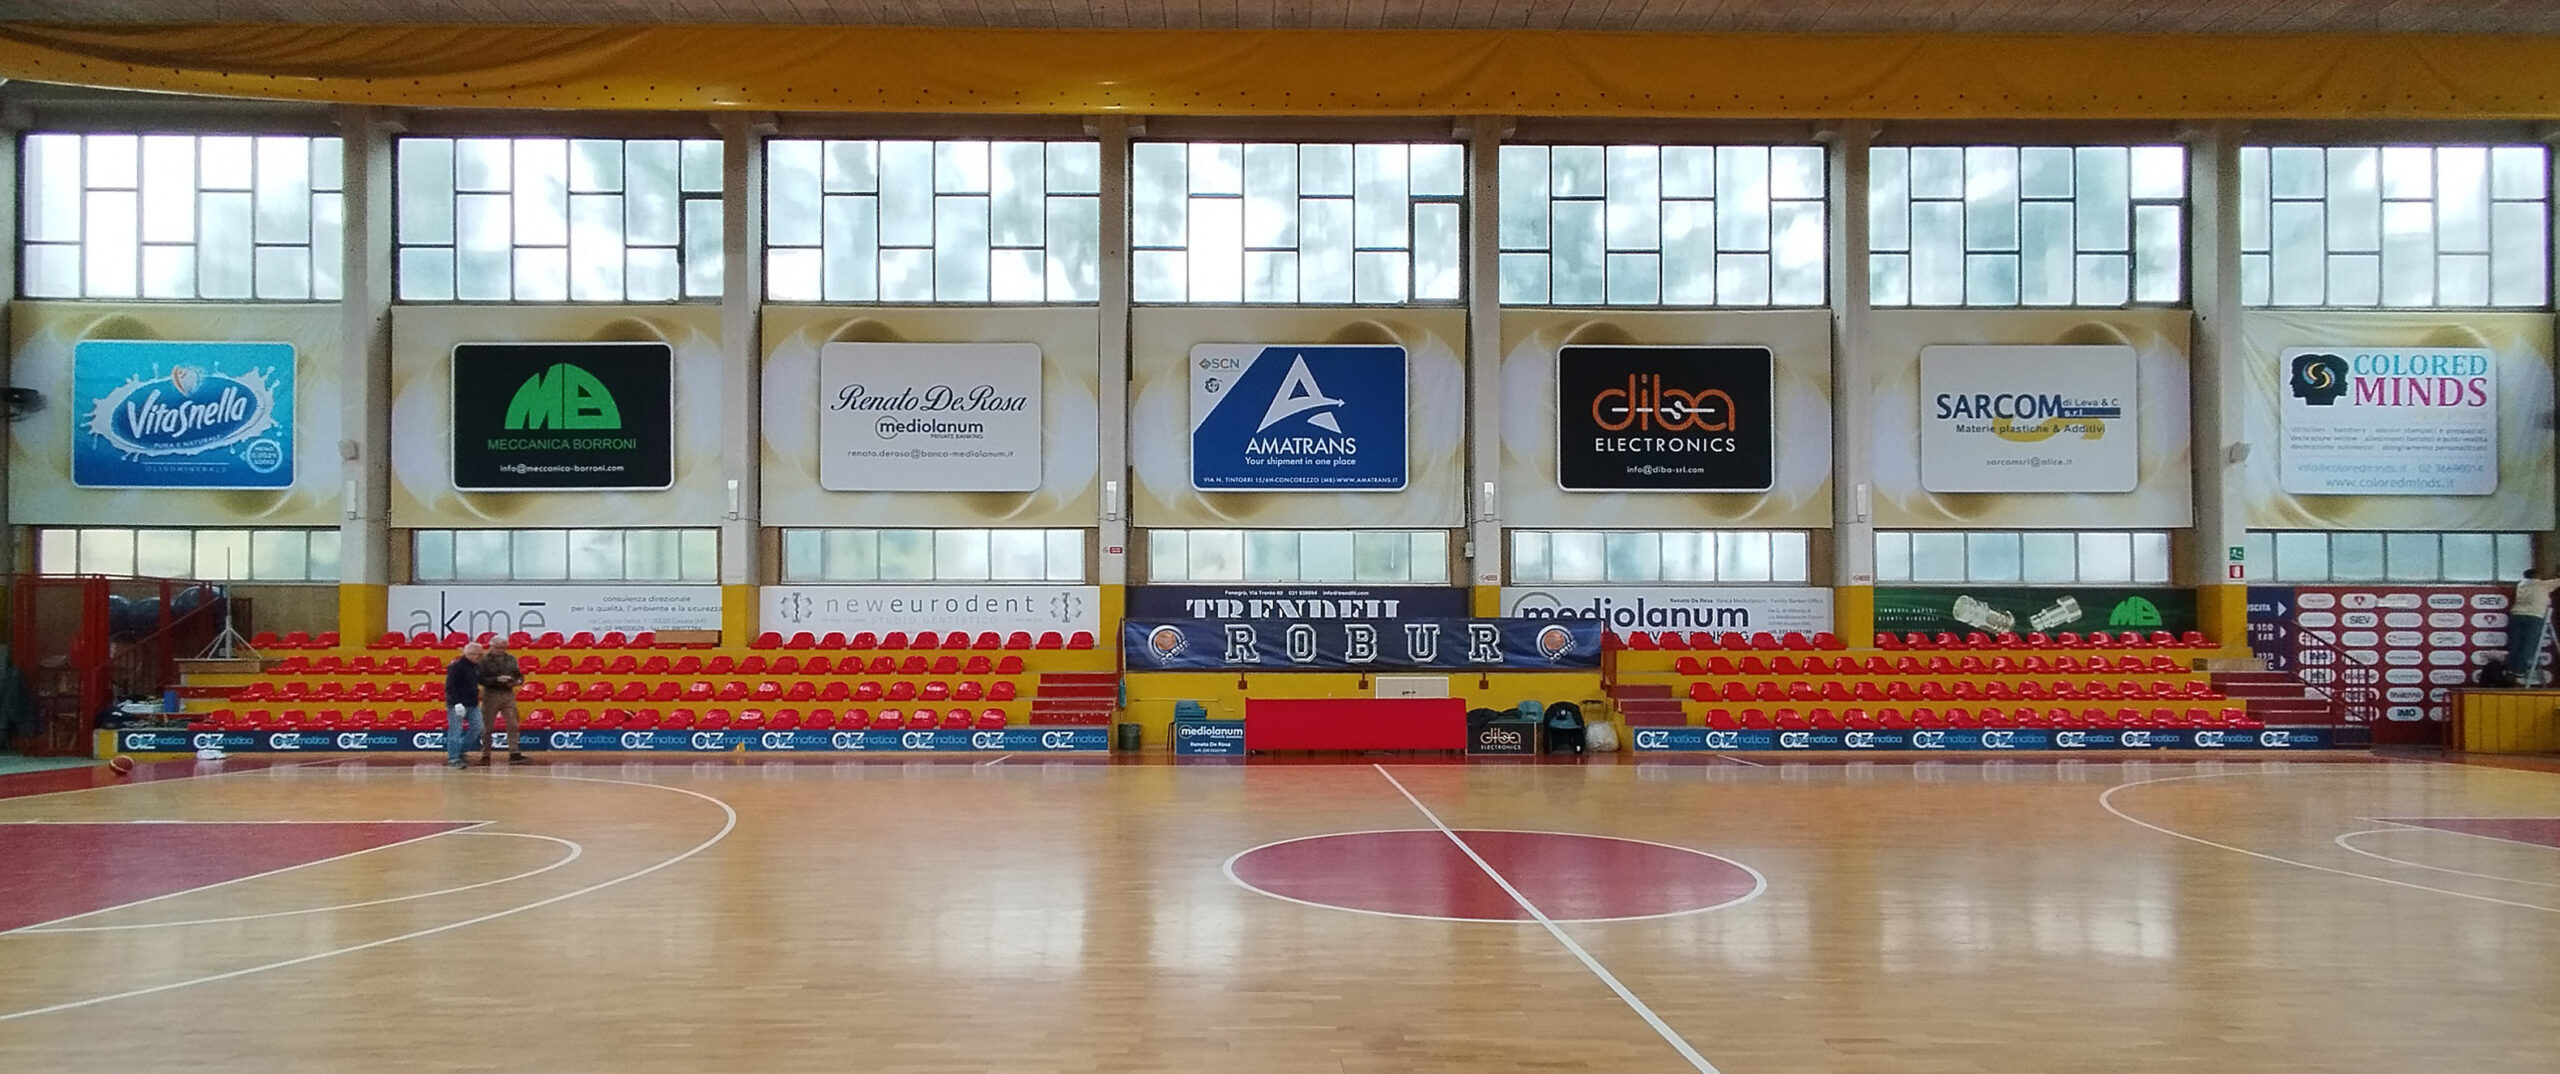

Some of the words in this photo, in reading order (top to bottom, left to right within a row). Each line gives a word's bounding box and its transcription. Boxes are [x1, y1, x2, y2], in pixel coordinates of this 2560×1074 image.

[1211, 358, 1240, 369] SCN
[2353, 353, 2488, 376] COLORED
[830, 384, 919, 412] Renato
[2353, 376, 2488, 407] MINDS
[1592, 373, 1736, 432] diba
[1936, 393, 2062, 420] SARCOM
[879, 419, 984, 434] mediolanum
[1956, 424, 1995, 433] Materie
[1999, 424, 2049, 435] plastiche
[2053, 424, 2061, 433] &
[487, 439, 570, 450] MECCANICA
[573, 438, 637, 450] BORRONI
[1245, 438, 1356, 455] AMATRANS
[1595, 438, 1736, 452] ELECTRONICS
[1245, 456, 1264, 465] Your
[1266, 456, 1303, 467] shipment
[1305, 456, 1313, 465] in
[1333, 456, 1356, 467] place
[499, 464, 625, 474] info@meccanica-borroni.com
[1626, 464, 1705, 475] info@diba-srl.com
[2349, 616, 2371, 625] SIEV
[1223, 623, 1504, 664] ROBUR
[1181, 725, 1244, 736] mediolanum
[1480, 727, 1522, 745] diba
